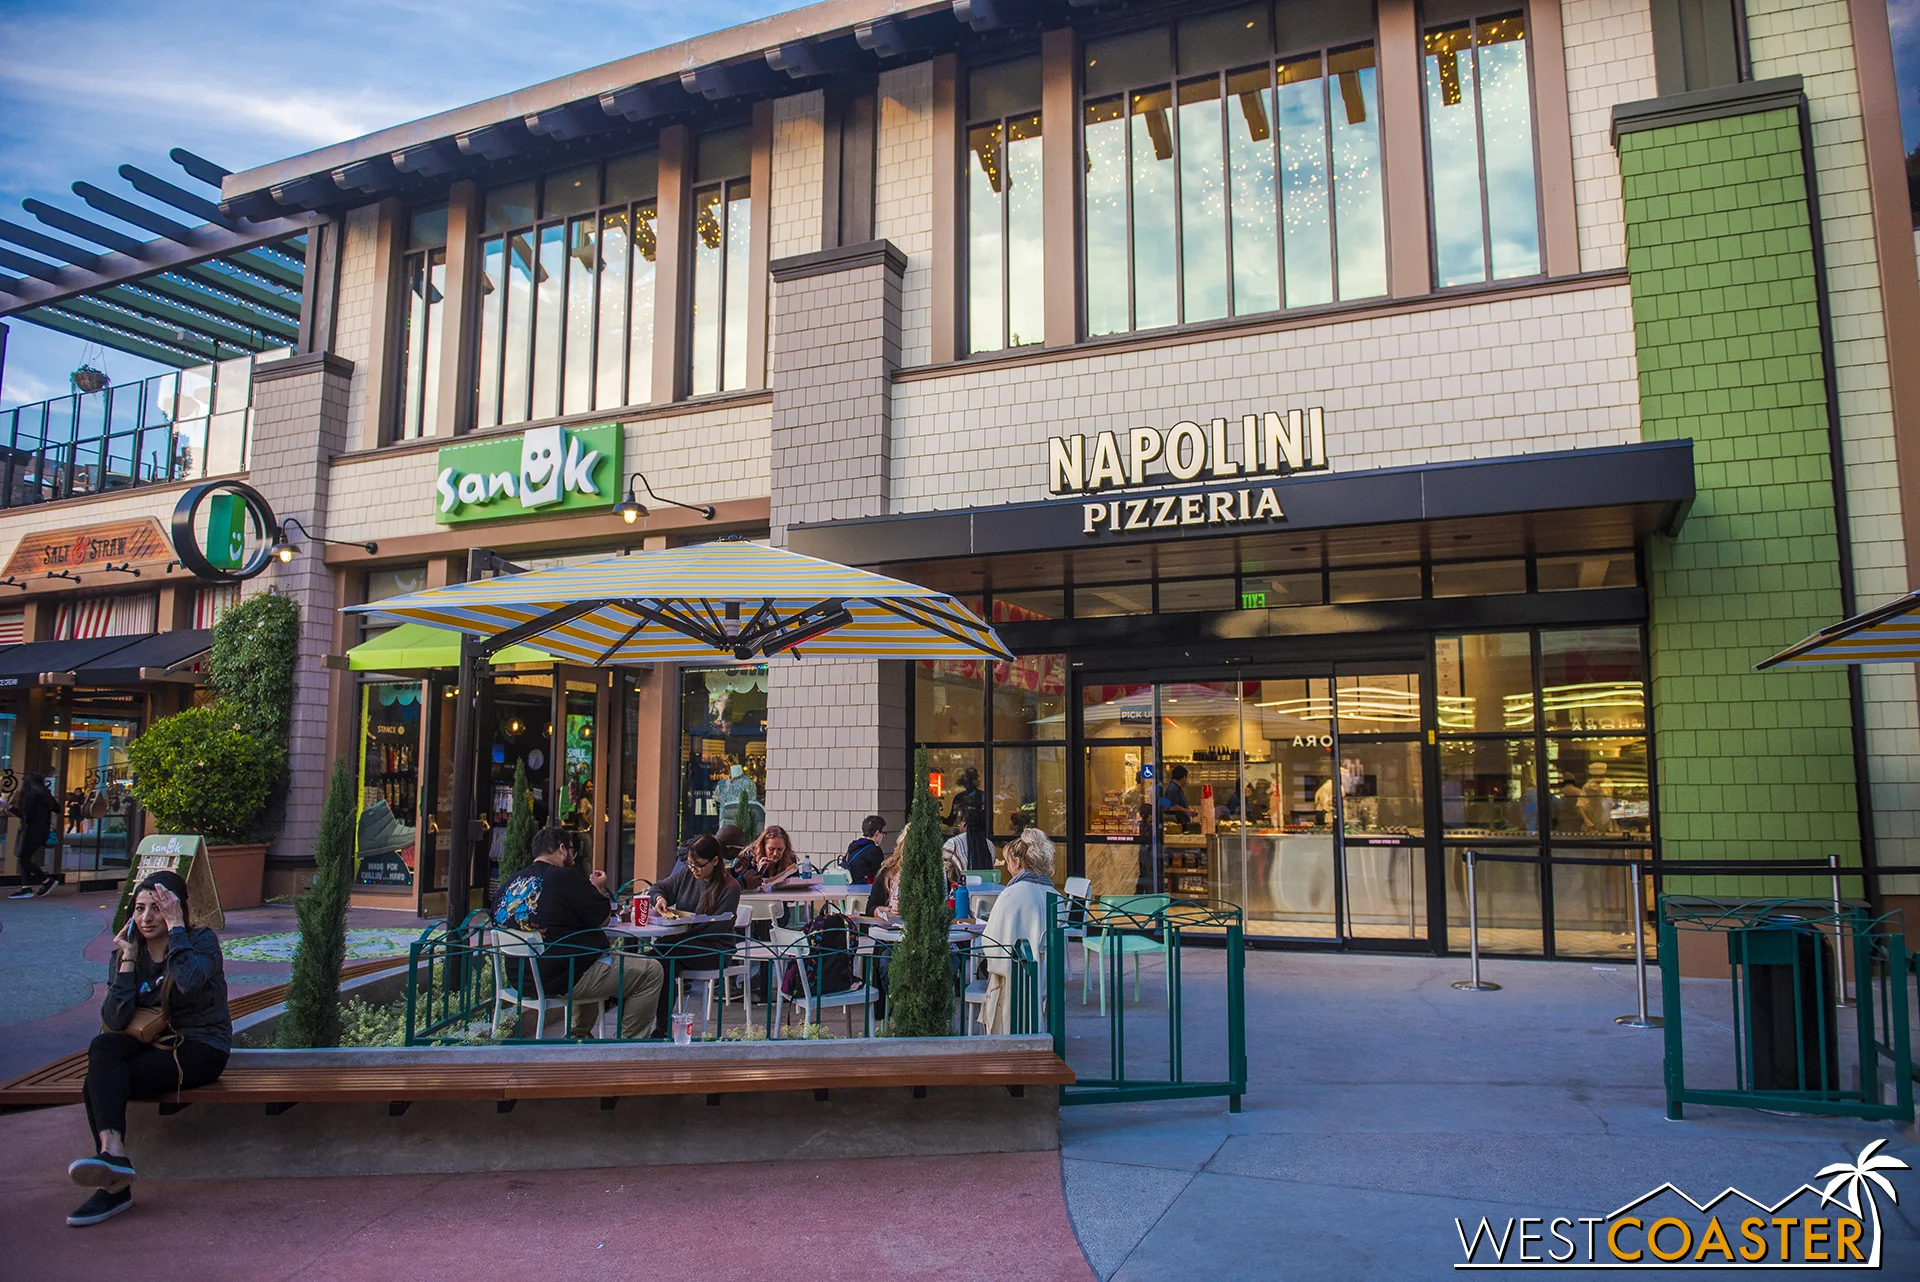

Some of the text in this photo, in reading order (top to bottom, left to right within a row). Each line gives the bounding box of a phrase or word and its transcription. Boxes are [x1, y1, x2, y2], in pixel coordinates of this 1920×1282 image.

[1048, 406, 1329, 495] NAPOLINI
[1082, 487, 1286, 534] PIZZERIA
[43, 536, 127, 565] SALT & STRAW
[1121, 711, 1142, 719] PICK
[377, 725, 396, 734] STANCE
[368, 862, 399, 871] MADE FOR
